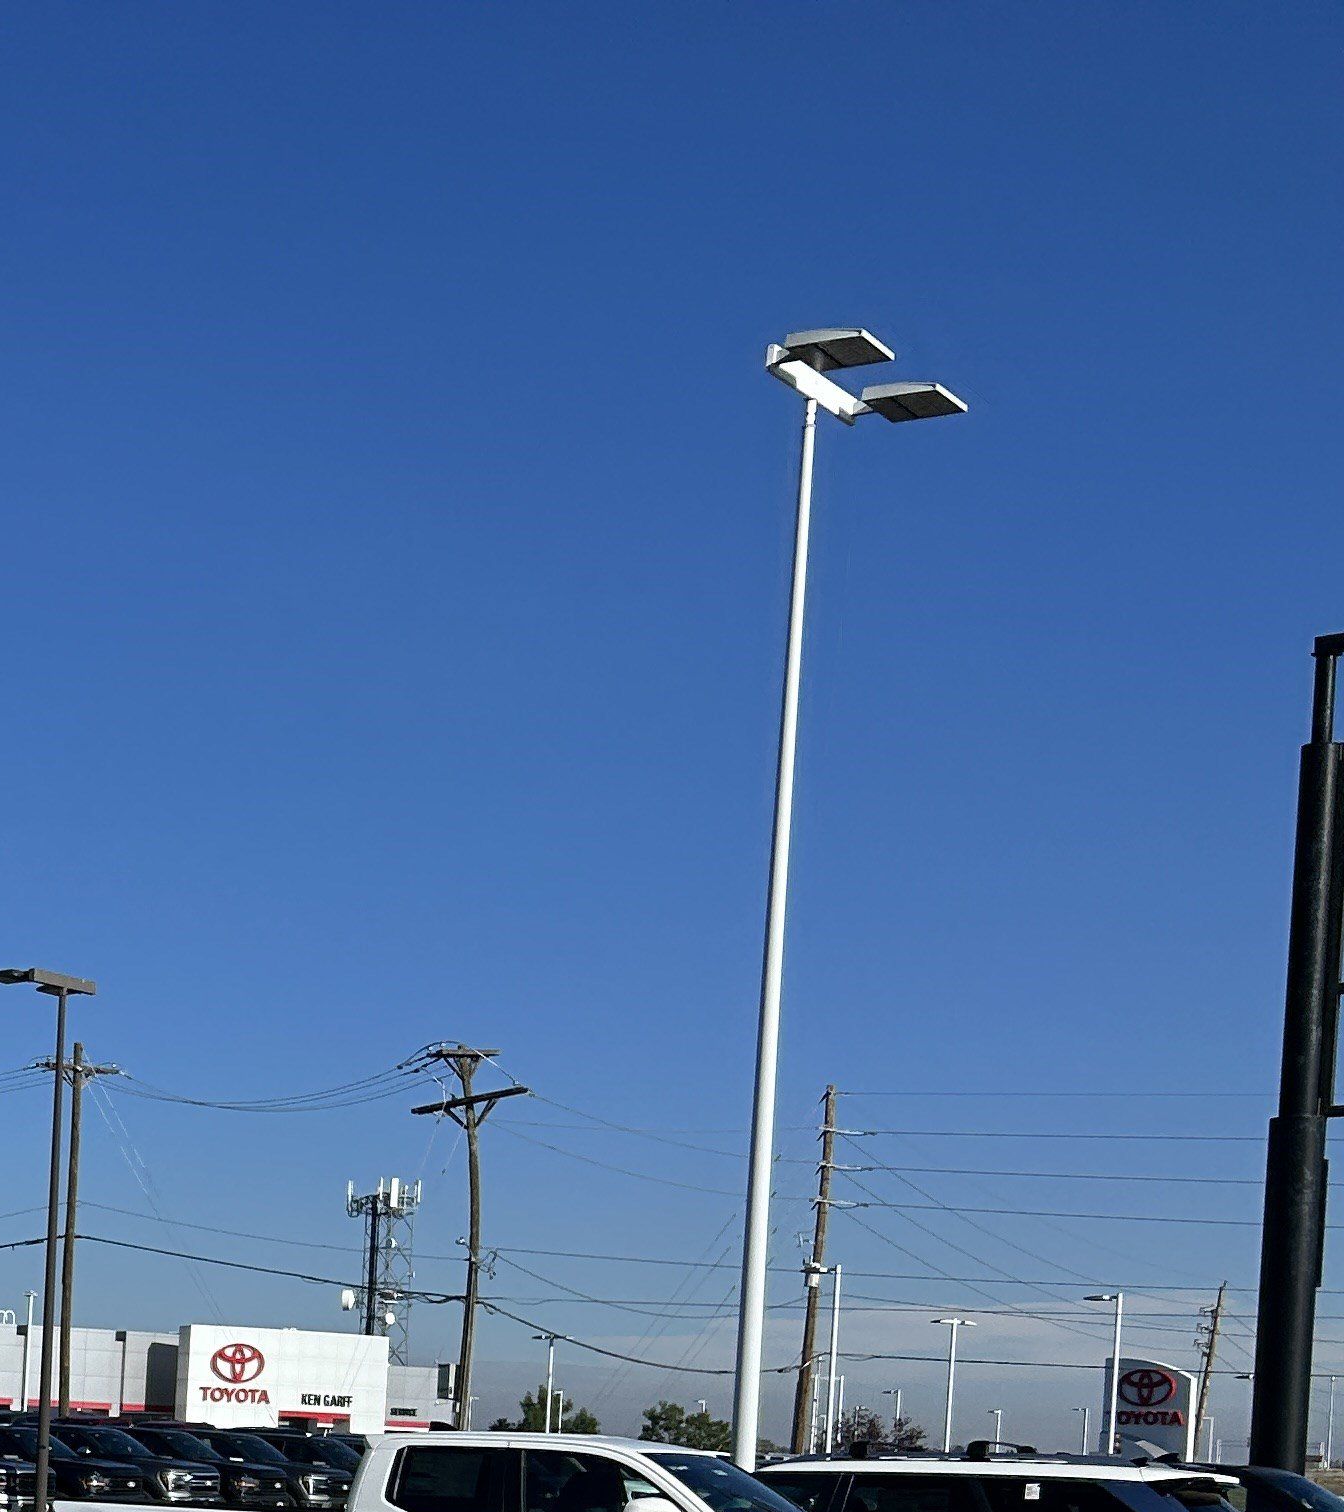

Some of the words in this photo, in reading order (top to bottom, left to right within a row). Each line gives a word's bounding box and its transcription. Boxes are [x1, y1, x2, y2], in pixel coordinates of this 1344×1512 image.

[199, 1386, 270, 1404] TOYOTA
[301, 1394, 321, 1406] KEN
[324, 1395, 353, 1408] GARFF
